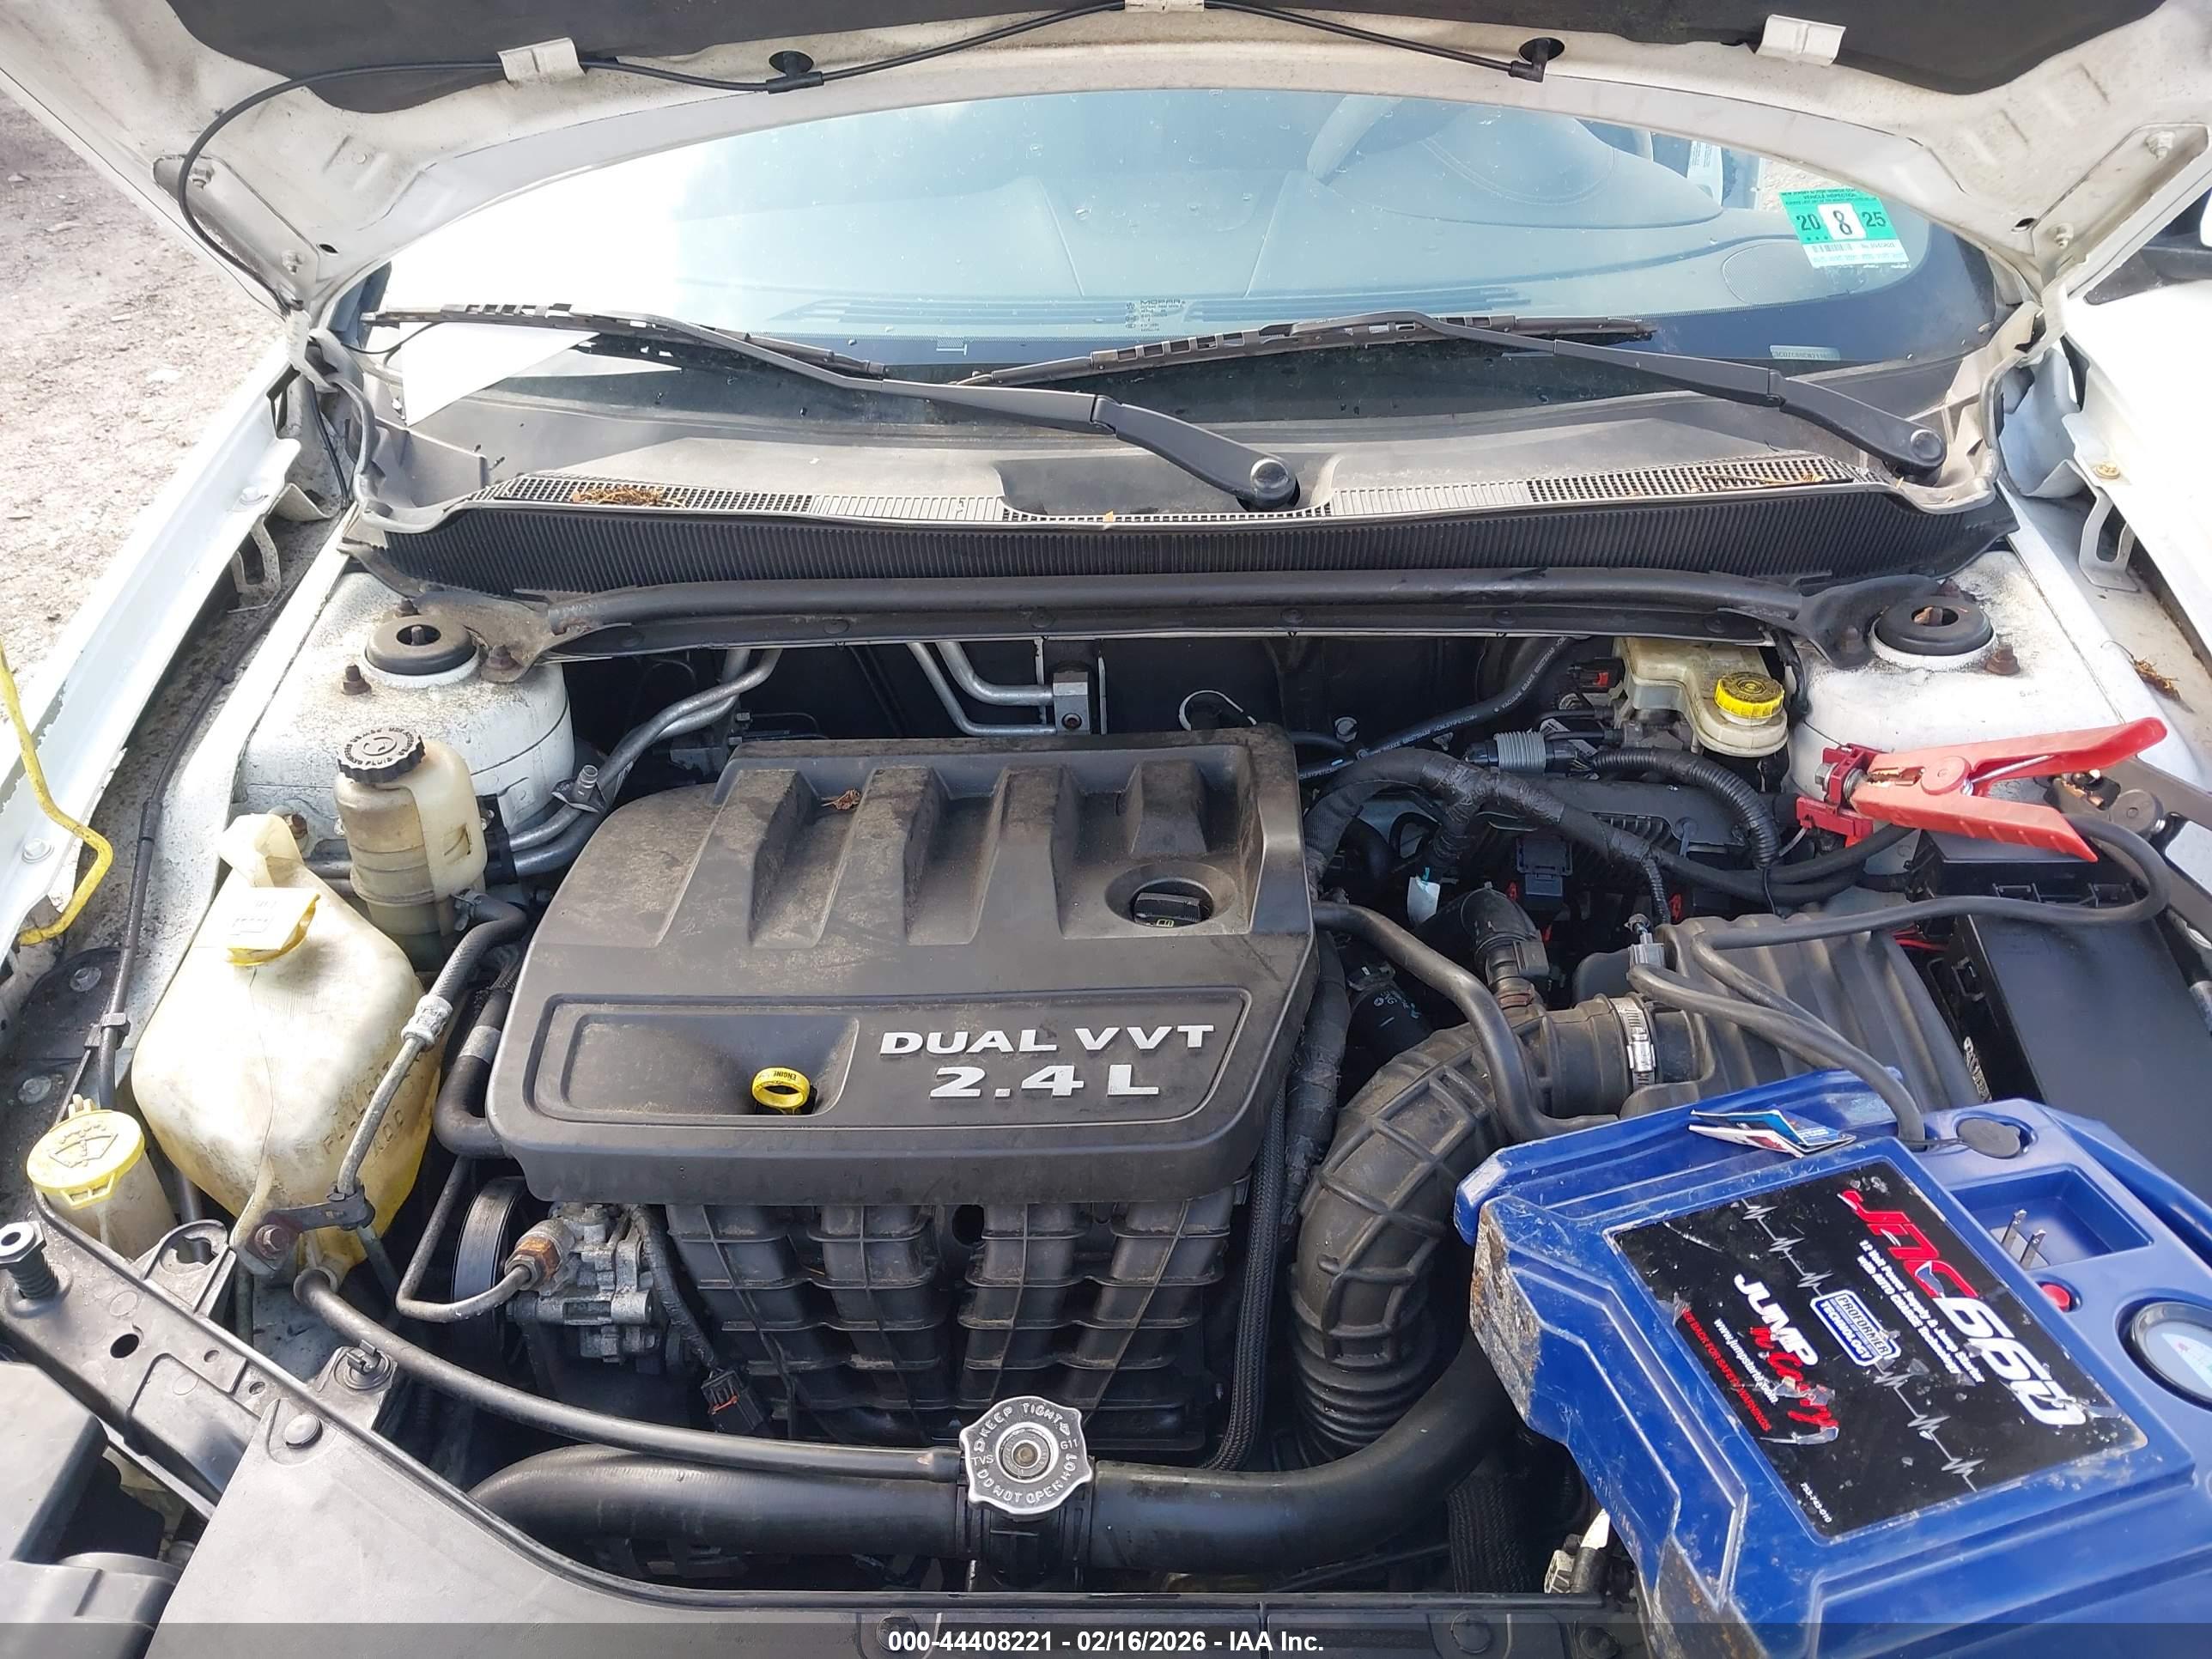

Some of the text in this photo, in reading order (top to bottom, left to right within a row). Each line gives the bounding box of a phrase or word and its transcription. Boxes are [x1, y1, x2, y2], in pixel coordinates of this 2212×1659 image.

[1796, 210, 1887, 235] 20 8 25
[879, 1024, 1215, 1055] DUAL VVT
[929, 1065, 1085, 1098] 2.4
[1735, 1274, 1819, 1365] JUMP
[1820, 1300, 1873, 1358] TECHNOLOGY
[1838, 1189, 2086, 1425] JNC660
[1838, 1296, 1889, 1354] PROFORMER
[1857, 1255, 1964, 1375] with AUTO CHARGE Technology
[1860, 1240, 1985, 1382] 12 Volt Power Supply & Jump Starter
[1690, 1322, 1711, 1344] BACK
[1705, 1342, 1723, 1360] FOR
[1737, 1388, 1771, 1430] WARNINGS
[980, 1402, 1063, 1437] KEEP TIGHT
[1060, 1438, 1079, 1449] G11
[972, 1455, 994, 1467] TVS
[977, 1453, 1078, 1504] DO NOT OPEN HOT
